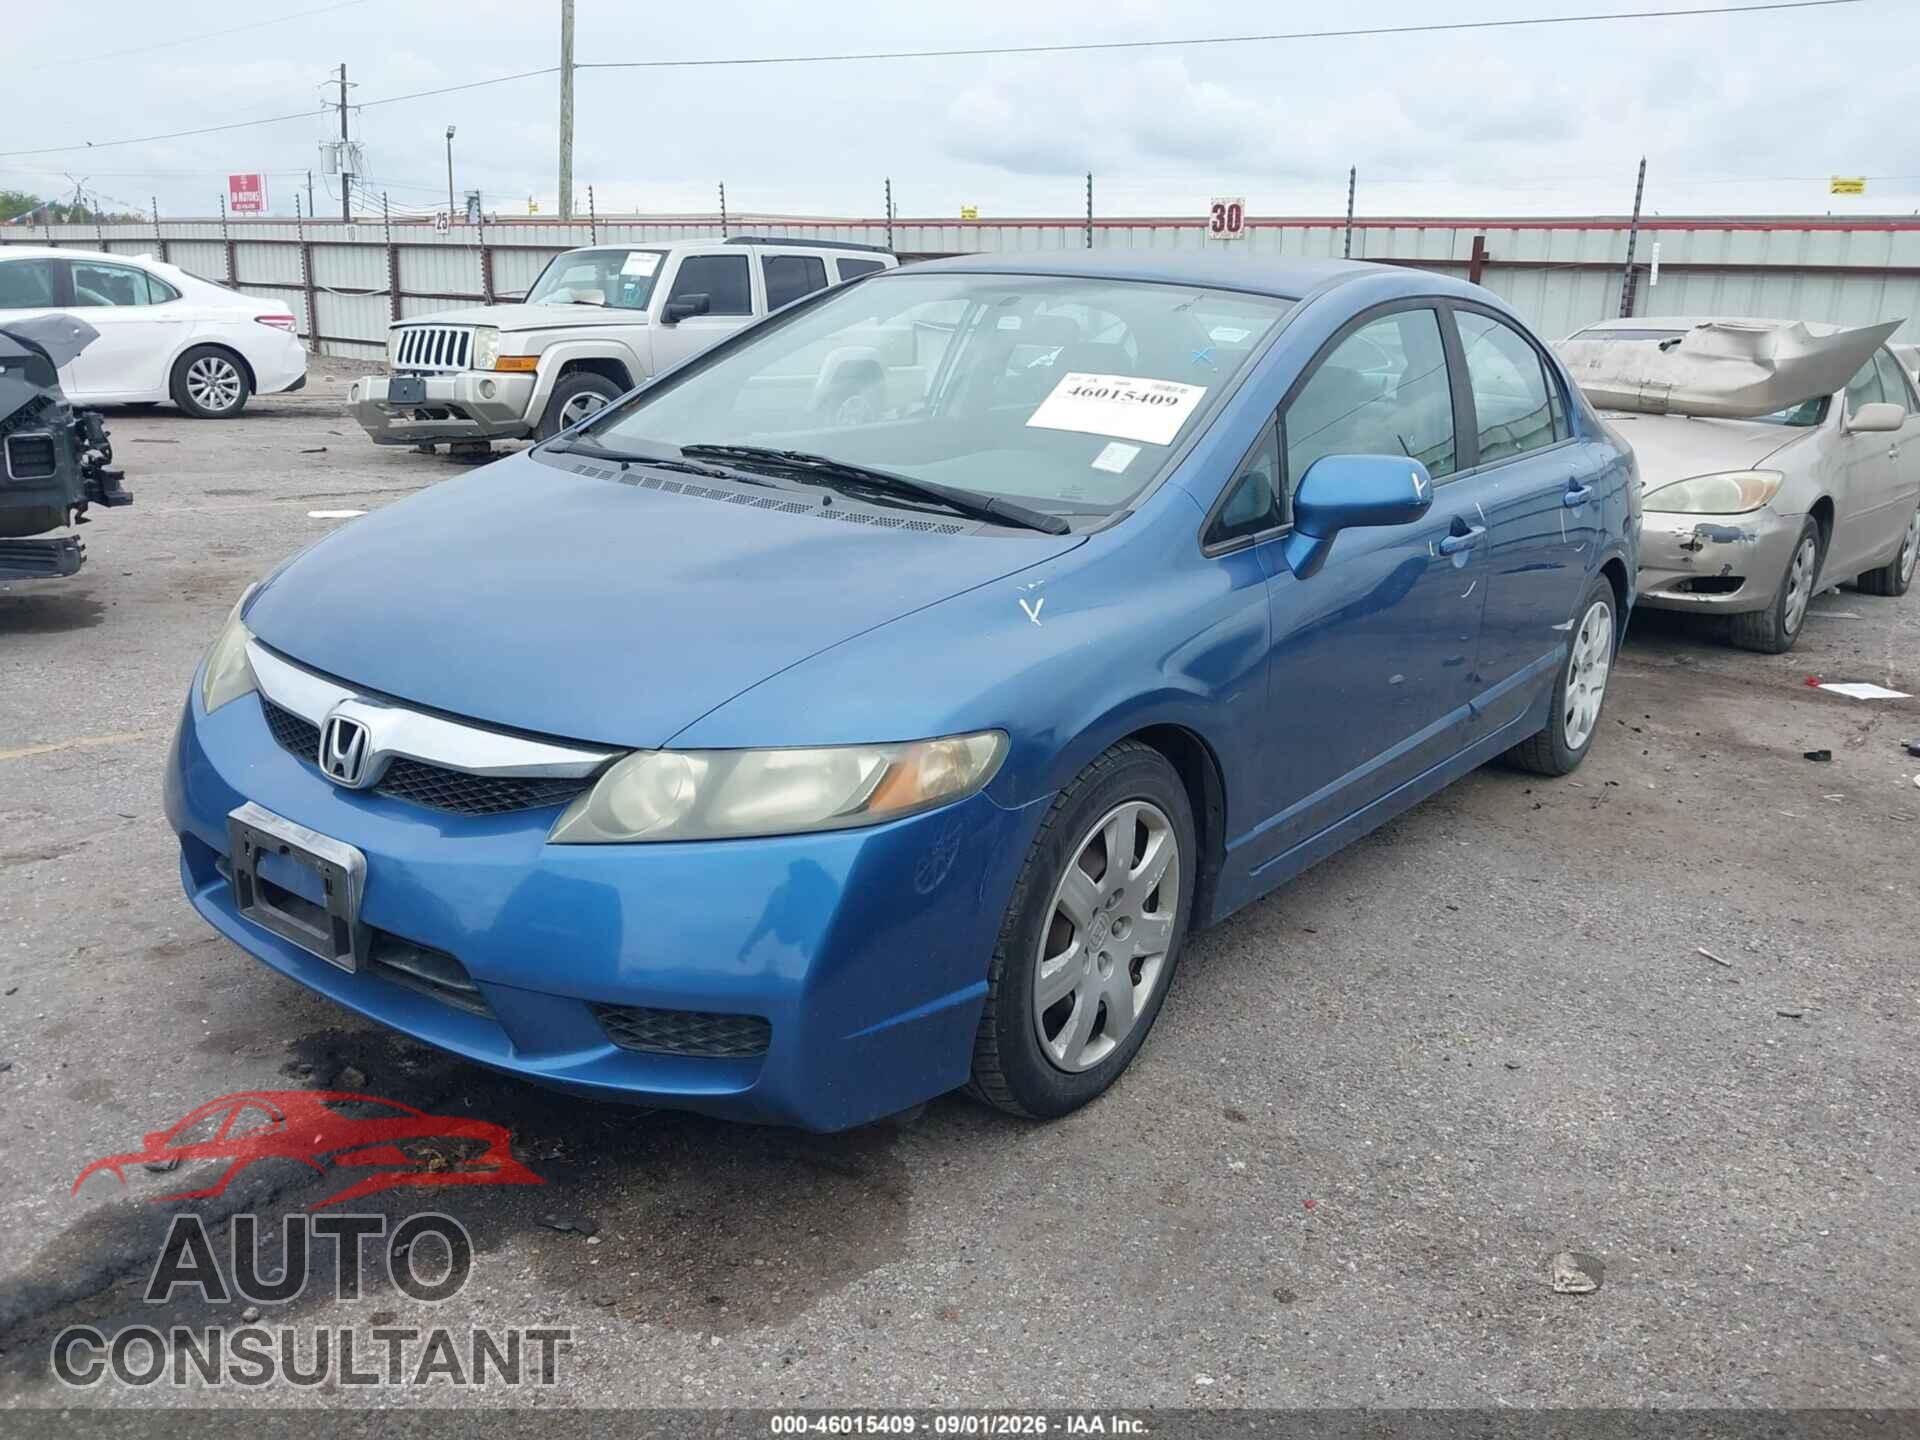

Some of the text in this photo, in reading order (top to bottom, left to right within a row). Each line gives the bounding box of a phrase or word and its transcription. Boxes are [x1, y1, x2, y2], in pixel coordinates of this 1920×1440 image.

[436, 212, 448, 230] 25
[1211, 203, 1242, 233] 30
[1067, 385, 1179, 407] 46015409
